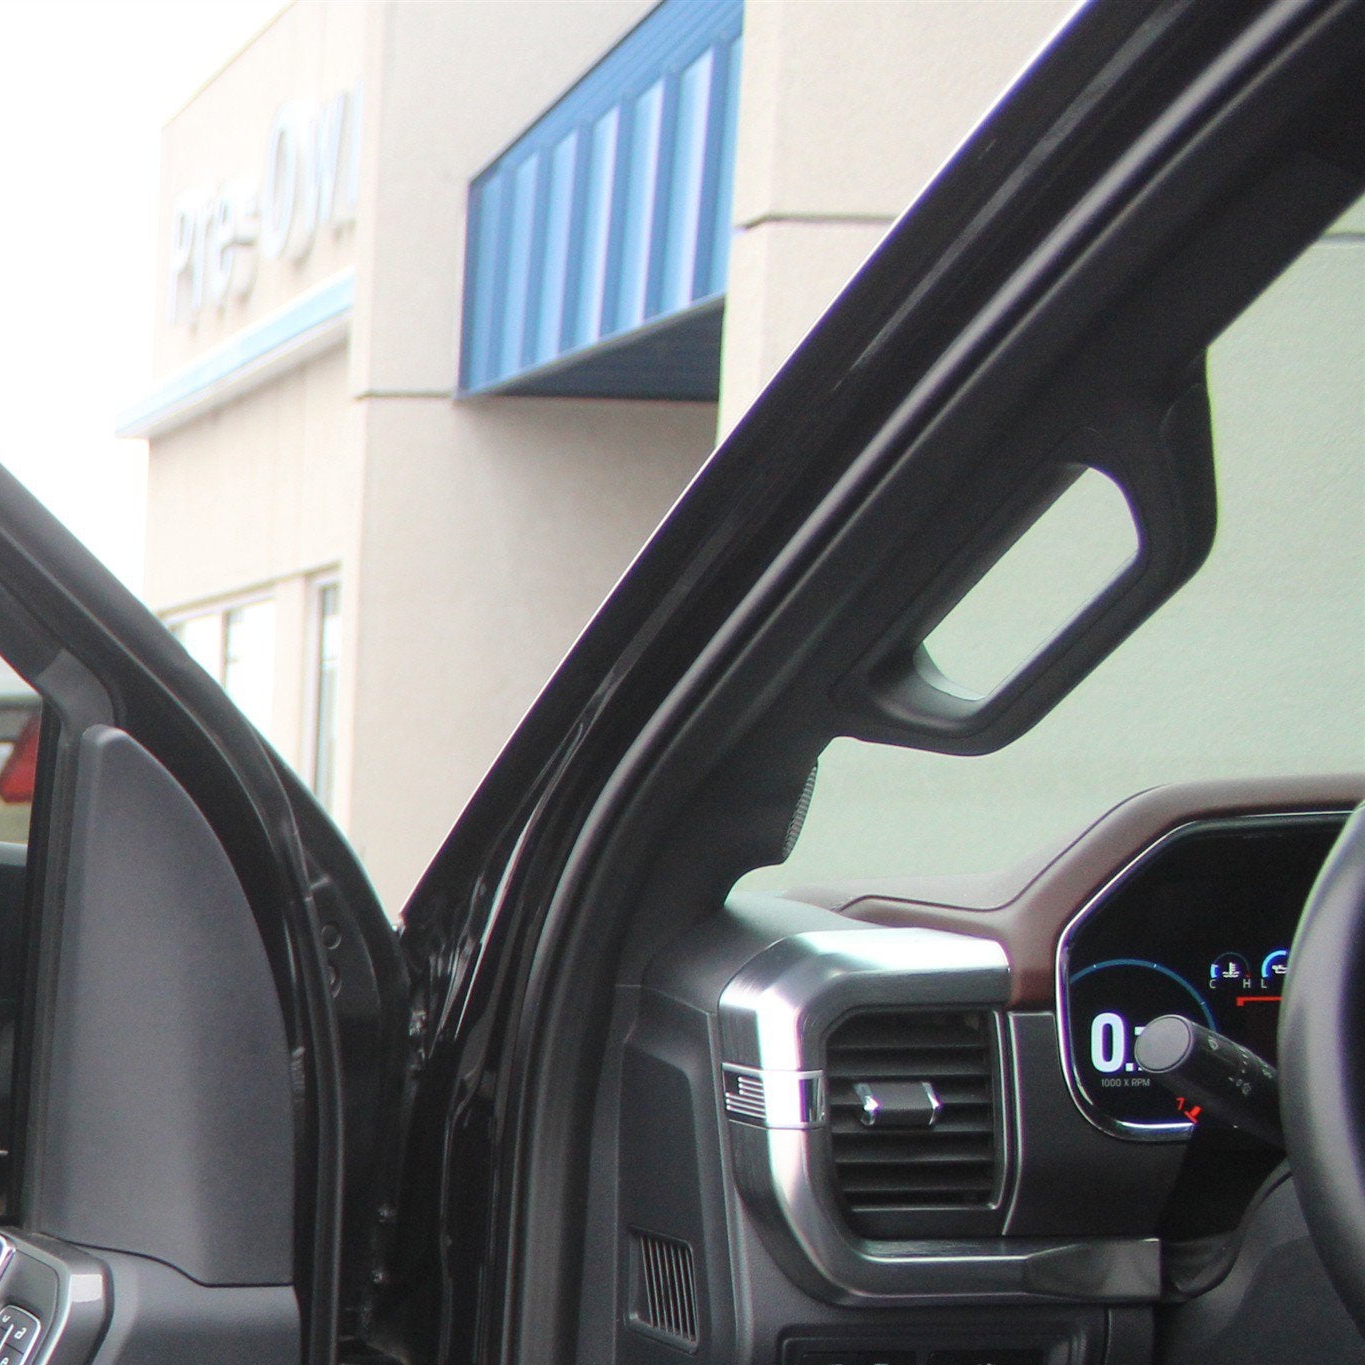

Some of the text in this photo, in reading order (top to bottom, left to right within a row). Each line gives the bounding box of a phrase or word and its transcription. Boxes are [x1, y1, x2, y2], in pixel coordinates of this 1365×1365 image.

[1209, 979, 1217, 989] C
[1243, 979, 1251, 989] H
[1261, 979, 1268, 989] L
[1101, 1078, 1121, 1087] 1000
[1131, 1078, 1150, 1087] RPM
[1176, 1097, 1185, 1111] 7
